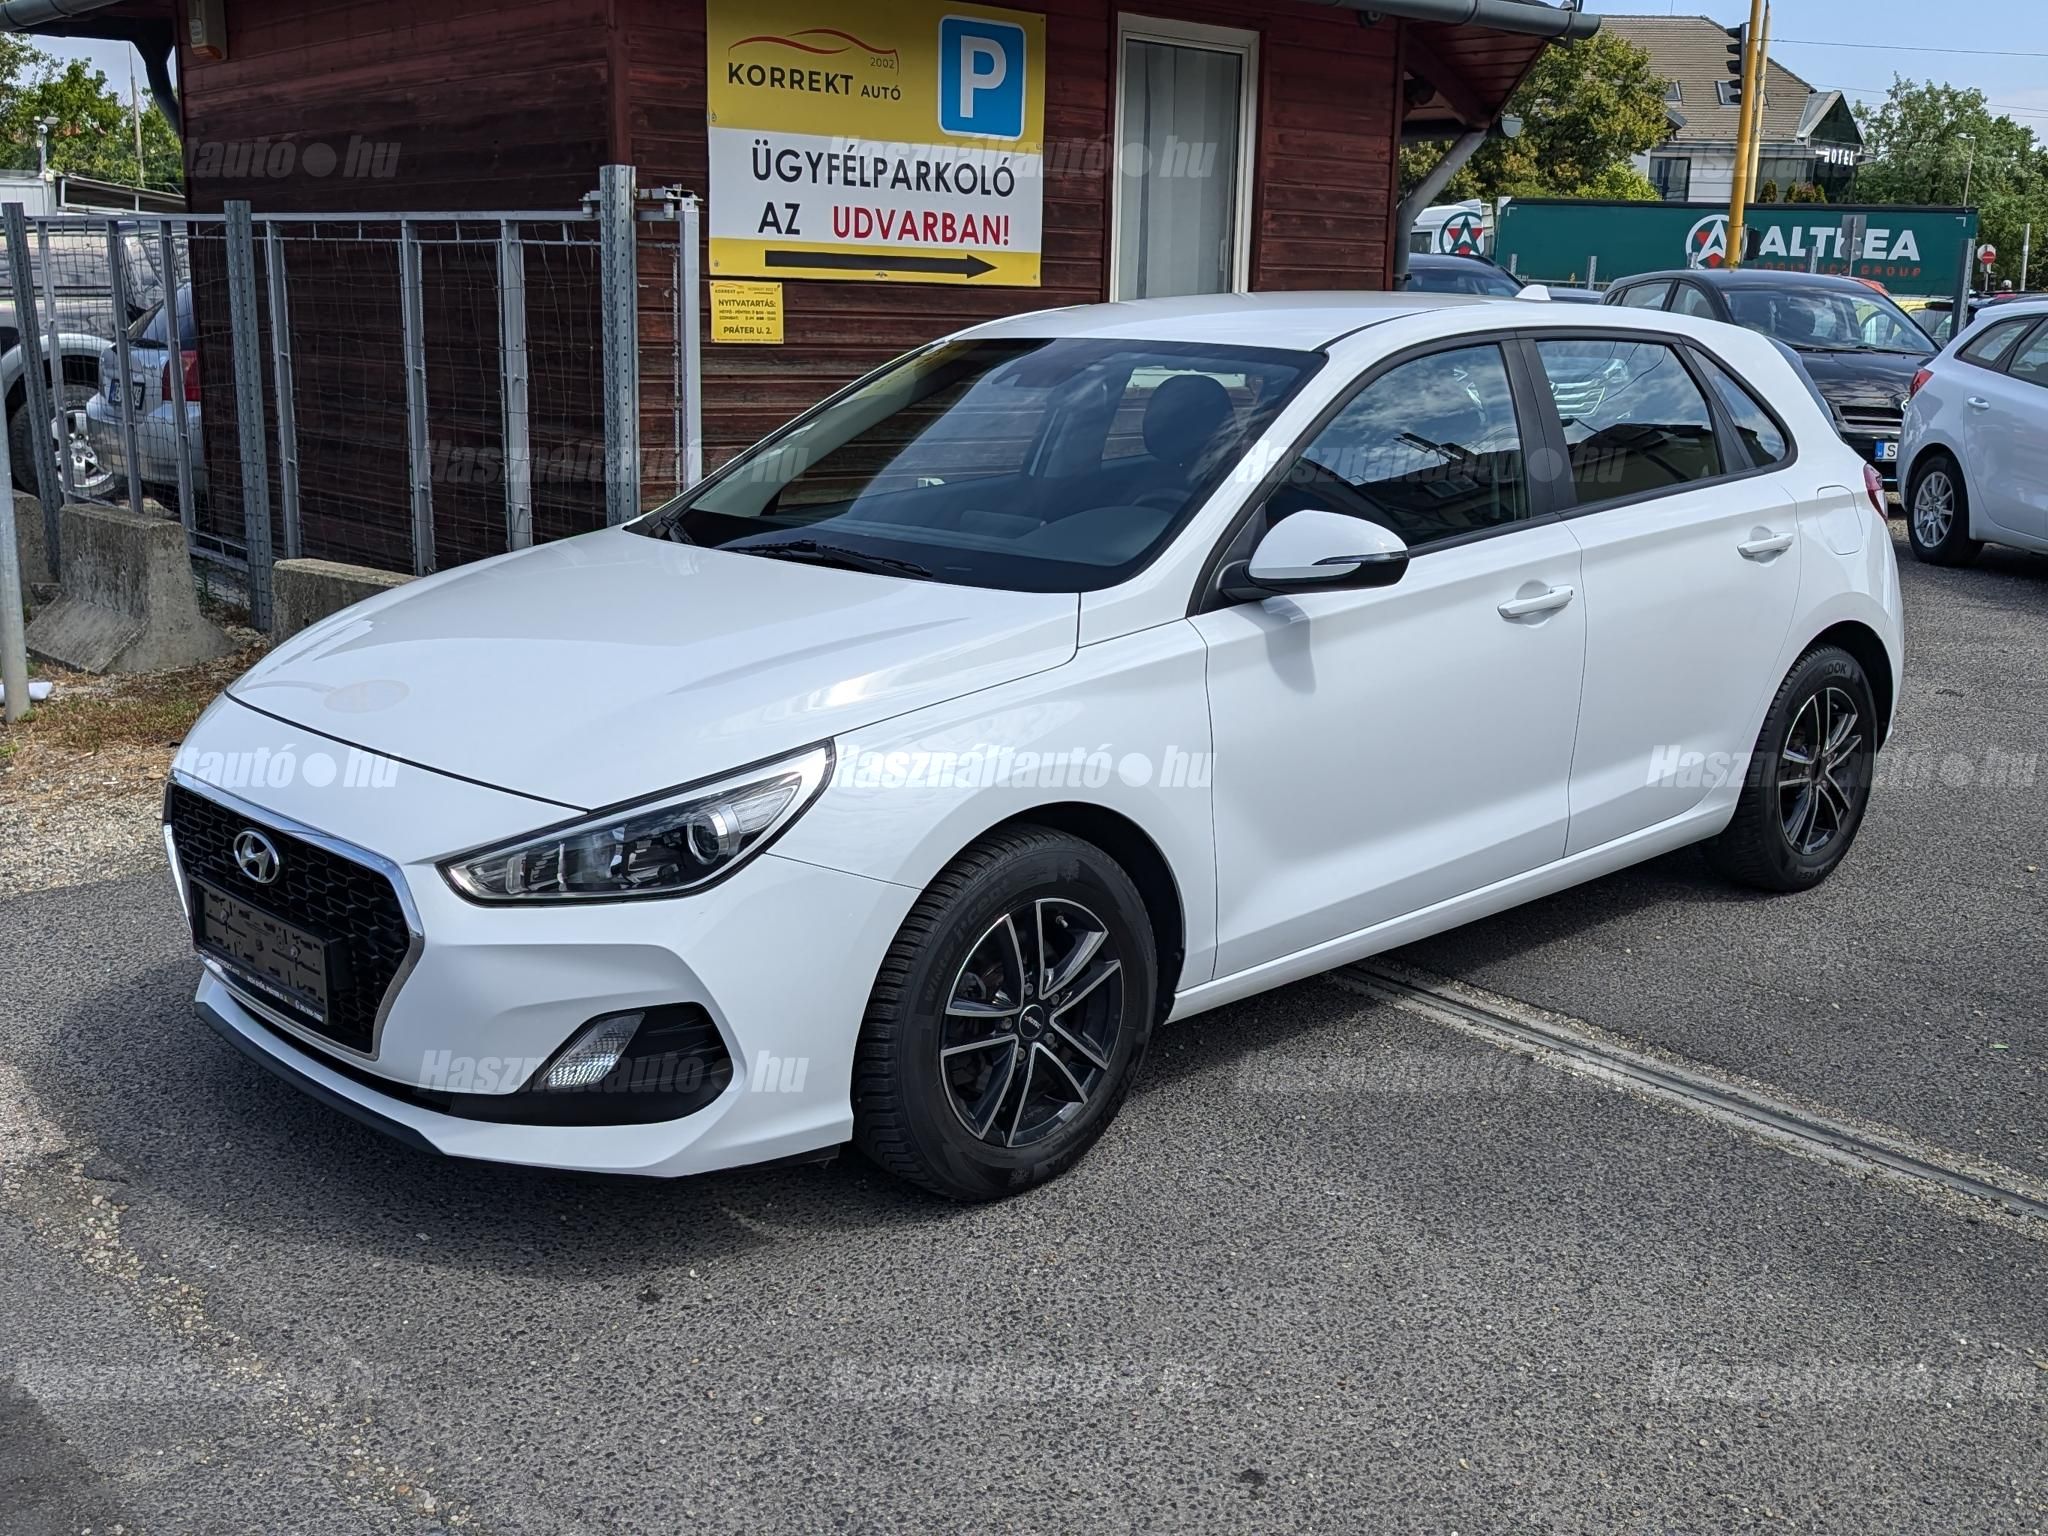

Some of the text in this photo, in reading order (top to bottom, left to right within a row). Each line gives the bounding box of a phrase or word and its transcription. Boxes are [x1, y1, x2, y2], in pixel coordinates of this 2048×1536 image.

[870, 57, 896, 70] 2002
[959, 34, 1007, 119] P
[727, 62, 901, 101] KORREKT AUTÓ
[751, 138, 1015, 198] ÜGYFÉLPARKOLÓ
[757, 201, 1010, 246] AZ UDVARBAN!
[1861, 264, 1921, 277] GROUP
[718, 298, 776, 308] NYITVATARTÁS:
[723, 324, 755, 335] PRÁTER
[757, 326, 764, 335] U.
